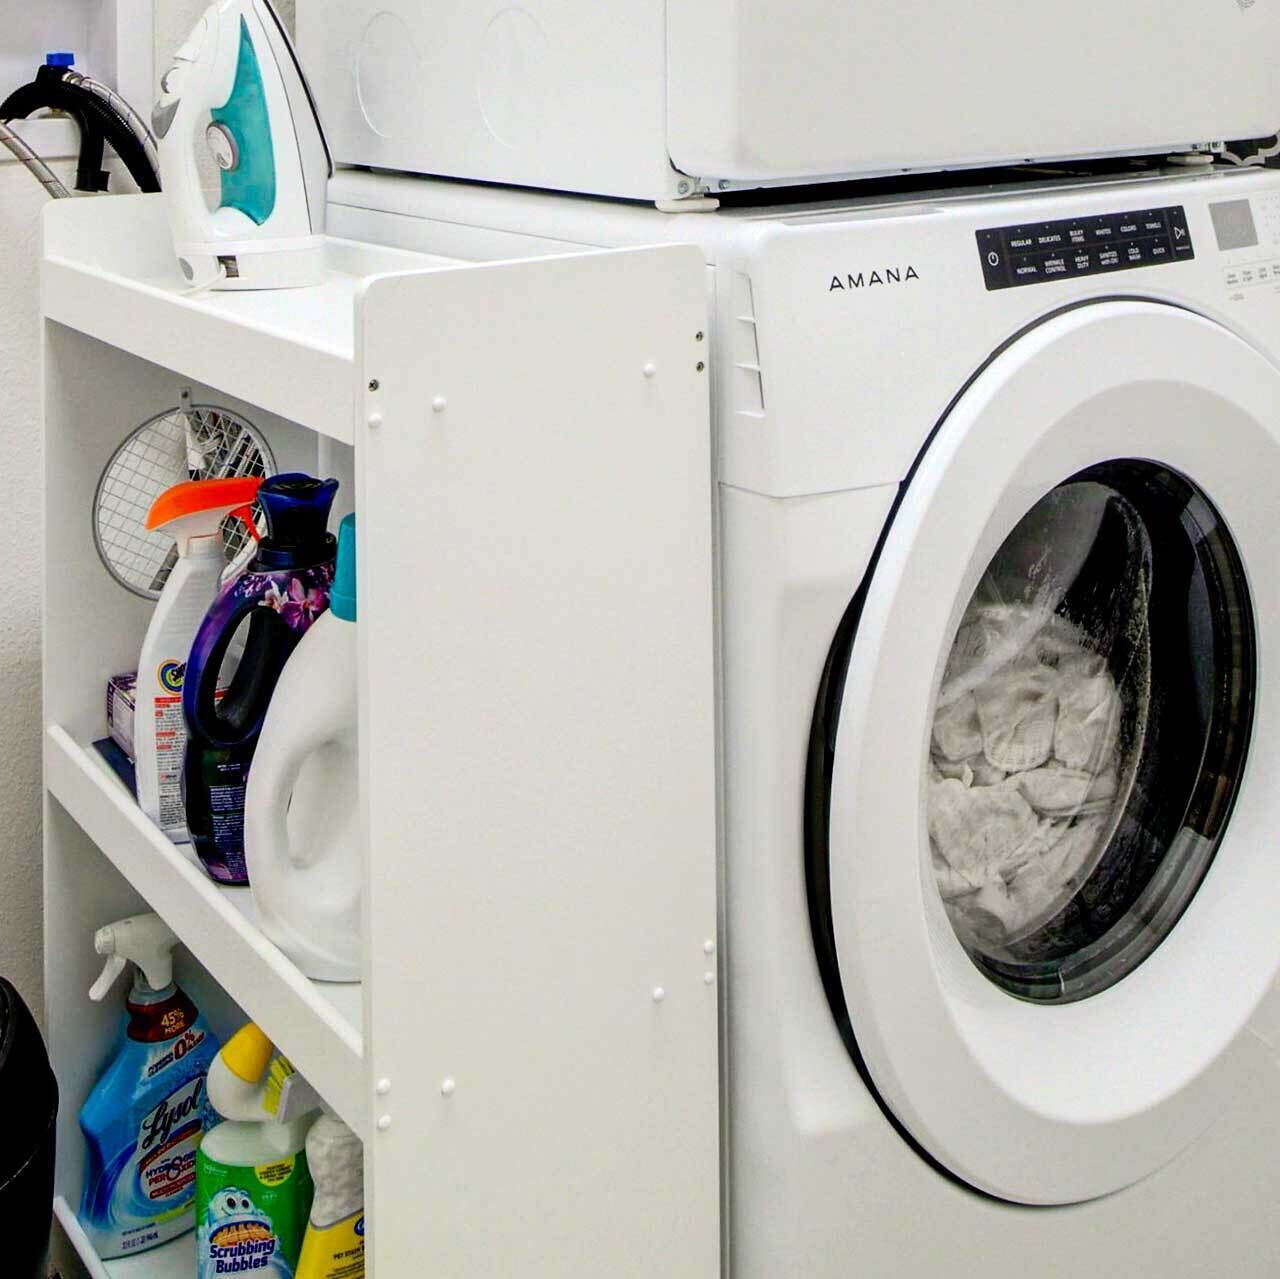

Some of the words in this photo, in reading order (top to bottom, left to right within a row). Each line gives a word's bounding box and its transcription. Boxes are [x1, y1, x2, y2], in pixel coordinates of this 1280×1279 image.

[829, 265, 920, 292] AMANA
[142, 1078, 203, 1150] Lysol
[210, 1239, 276, 1259] Scrubbing
[216, 1255, 269, 1274] Bubbles
